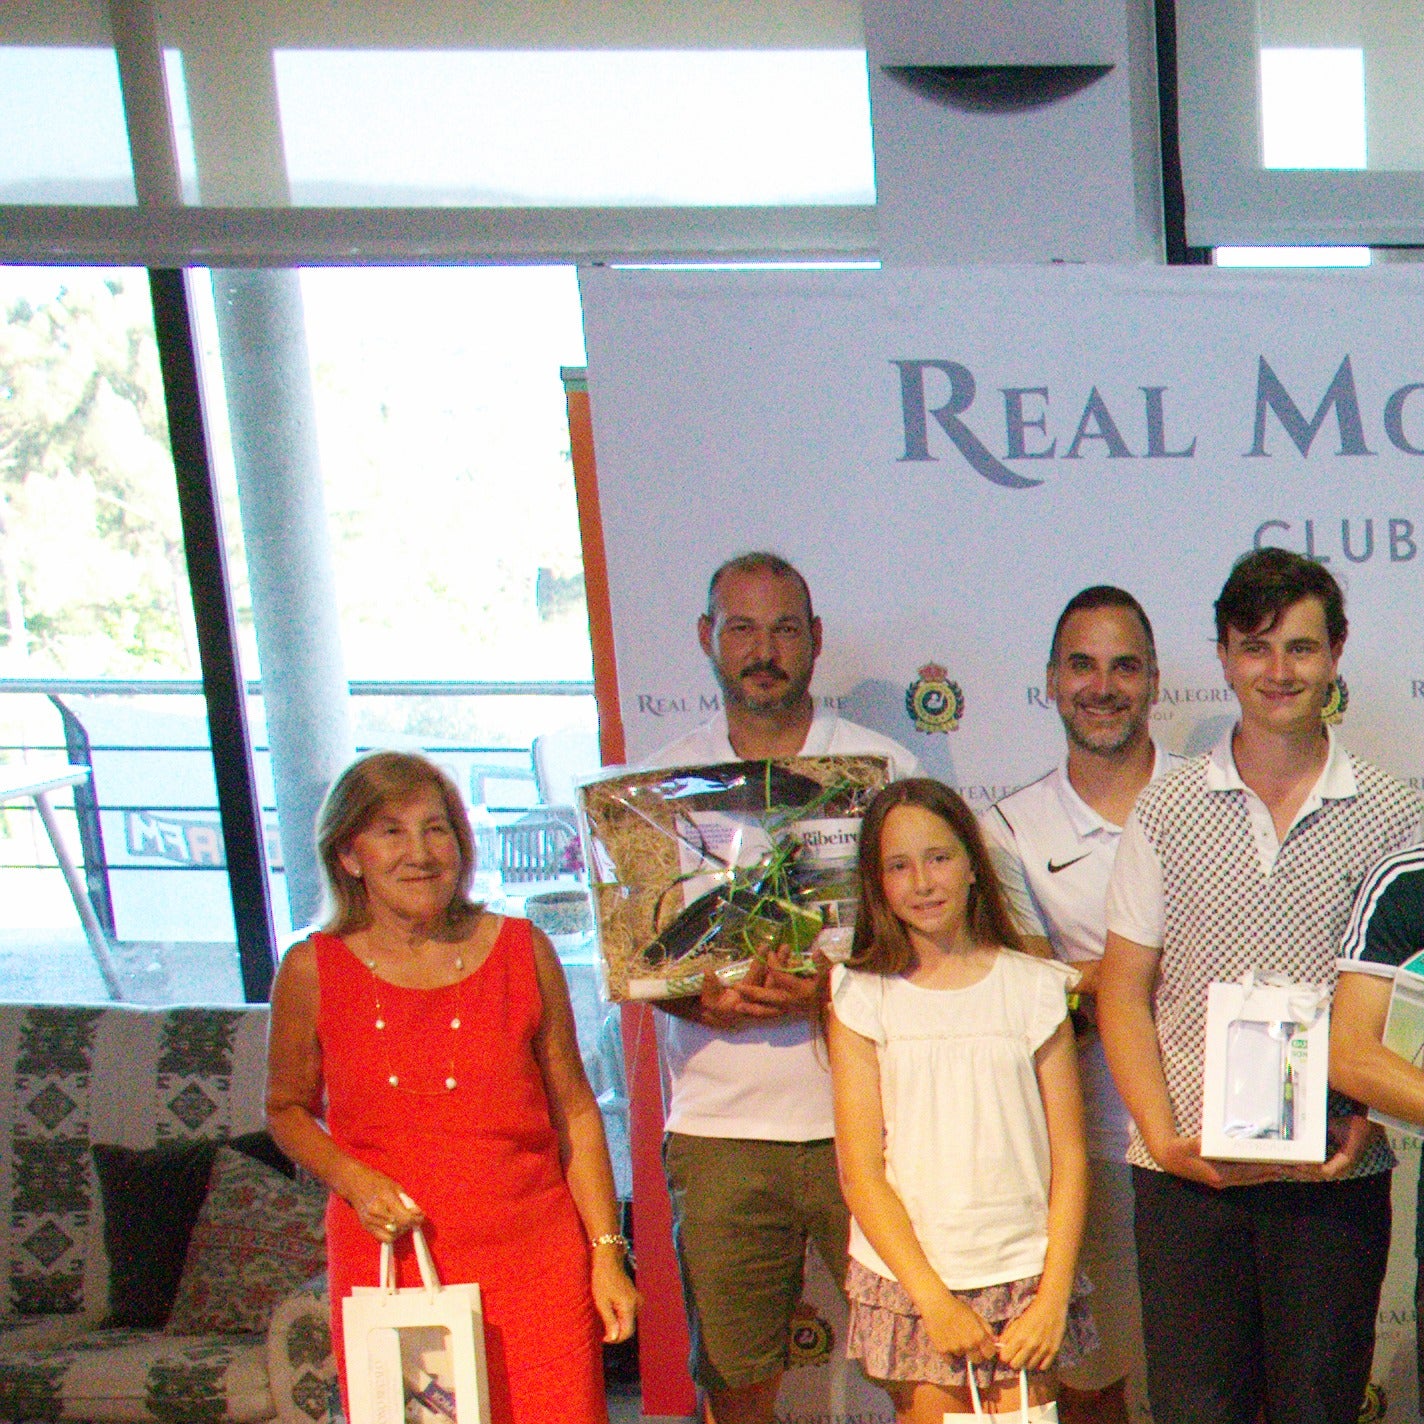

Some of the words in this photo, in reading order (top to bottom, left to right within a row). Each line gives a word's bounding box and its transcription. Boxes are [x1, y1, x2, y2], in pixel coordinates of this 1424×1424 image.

[889, 357, 1197, 489] REAL
[1253, 517, 1418, 563] CLUB
[1162, 688, 1232, 706] ALEGRE
